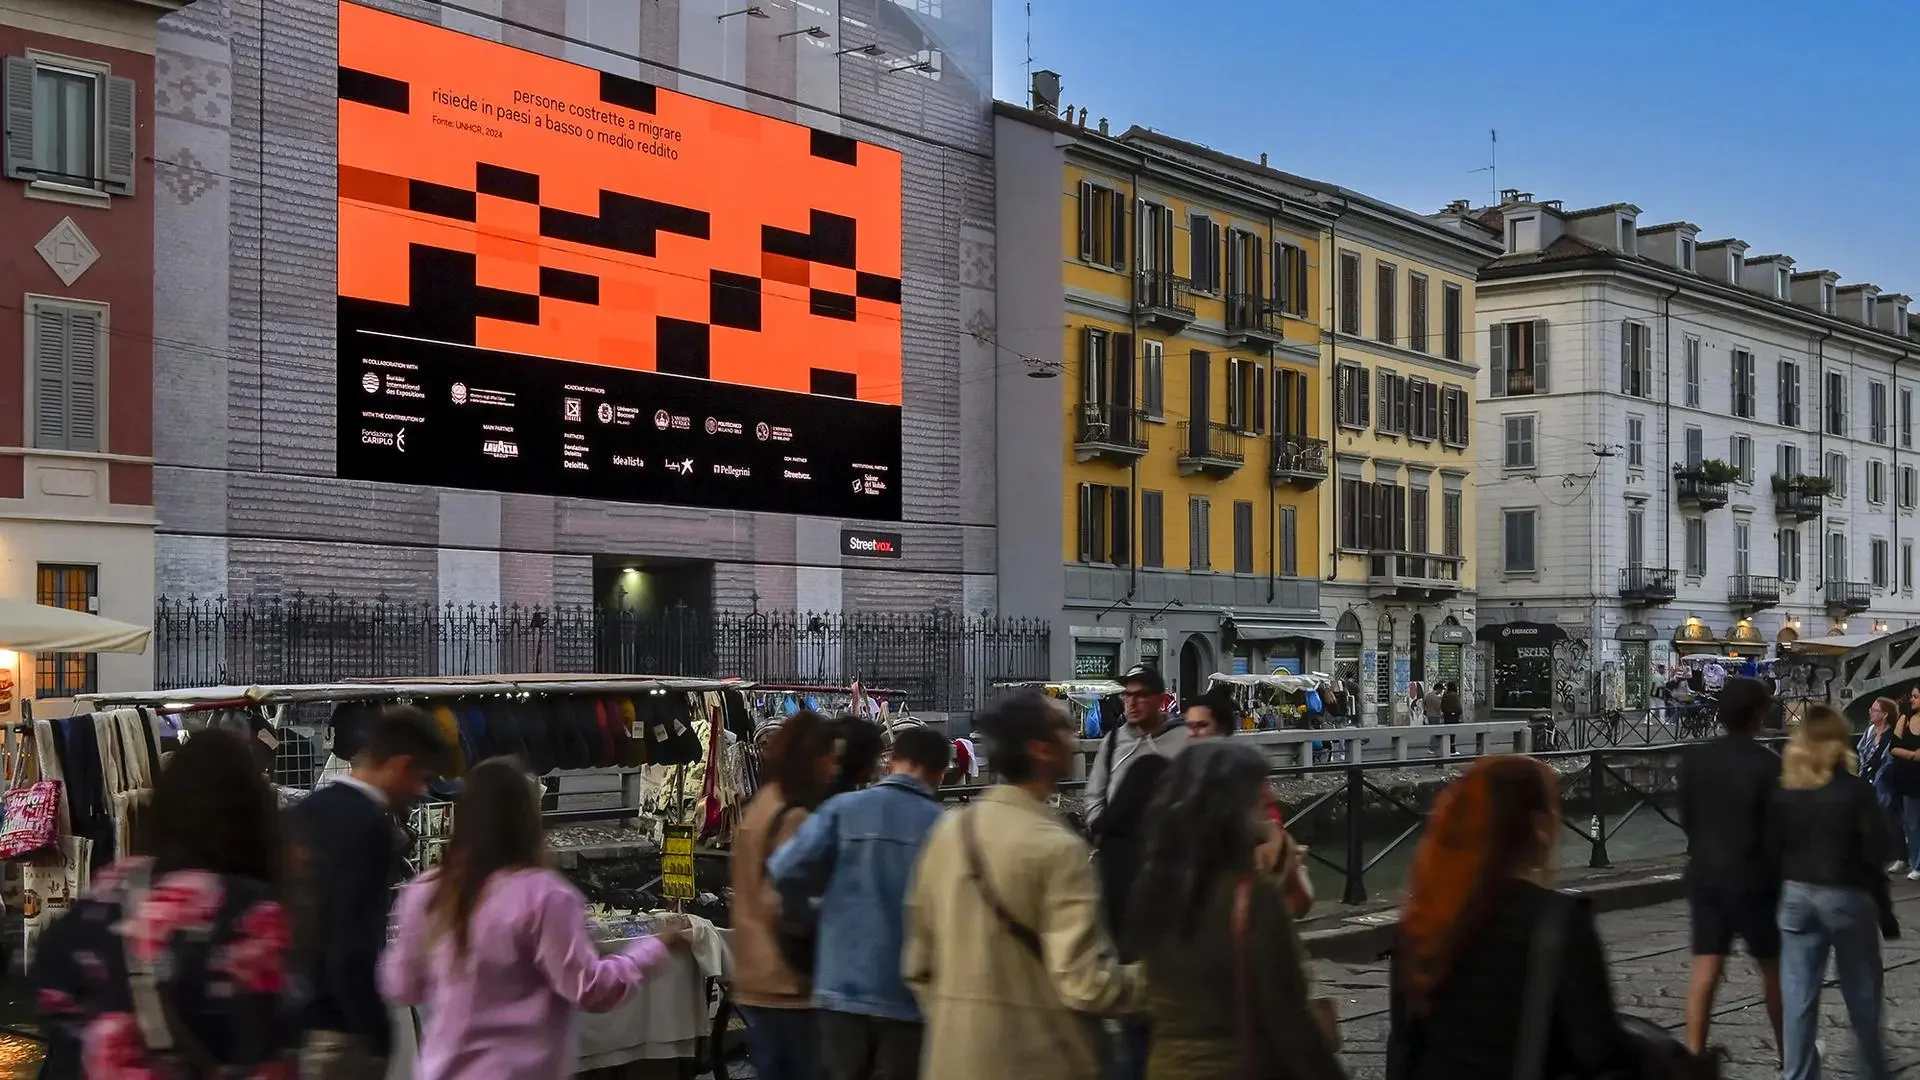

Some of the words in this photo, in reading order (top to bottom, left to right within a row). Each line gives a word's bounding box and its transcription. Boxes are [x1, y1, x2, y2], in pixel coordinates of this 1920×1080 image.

[513, 90, 565, 112] persone
[569, 104, 625, 128] costrette
[628, 119, 636, 130] a
[638, 120, 682, 142] migrare
[432, 87, 478, 111] risiede
[481, 97, 493, 115] in
[496, 106, 531, 125] paesi
[534, 115, 542, 127] a
[545, 114, 583, 137] basso
[585, 128, 594, 140] o
[597, 130, 635, 150] medio
[637, 140, 679, 161] reddito
[432, 115, 454, 128] Fonte:
[455, 121, 484, 135] UNHCR,
[485, 127, 503, 139] 2024
[368, 359, 406, 369] COLLABORATION
[386, 381, 420, 391] International
[396, 389, 425, 399] Expositions
[362, 428, 393, 438] Fondazione
[362, 436, 393, 446] CARIPLO
[483, 440, 518, 455] LAVAZZA
[613, 455, 644, 467] idealista
[720, 465, 750, 478] Pellegrini
[849, 536, 894, 552] Streetvox.
